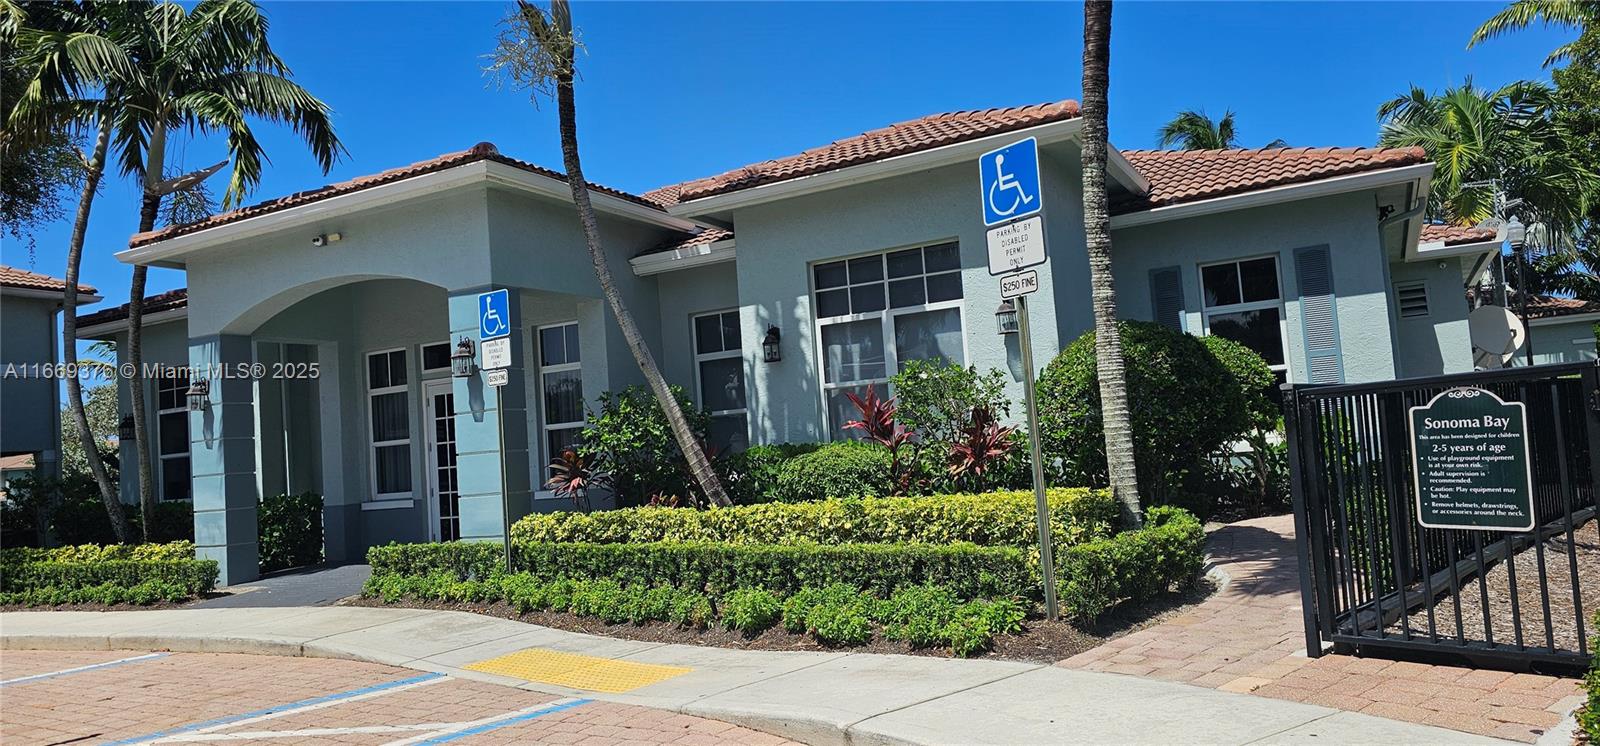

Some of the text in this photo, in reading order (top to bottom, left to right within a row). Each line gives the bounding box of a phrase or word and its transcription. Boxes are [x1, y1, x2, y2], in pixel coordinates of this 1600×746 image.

[996, 225, 1020, 238] PARKING
[1002, 234, 1028, 248] DISABLED
[1006, 246, 1026, 256] PERMIT
[1010, 256, 1024, 266] ONLY
[1002, 276, 1036, 292] $250 FINE
[1424, 416, 1510, 430] Sonoma Bay
[1433, 443, 1506, 454] 2-5 years of age
